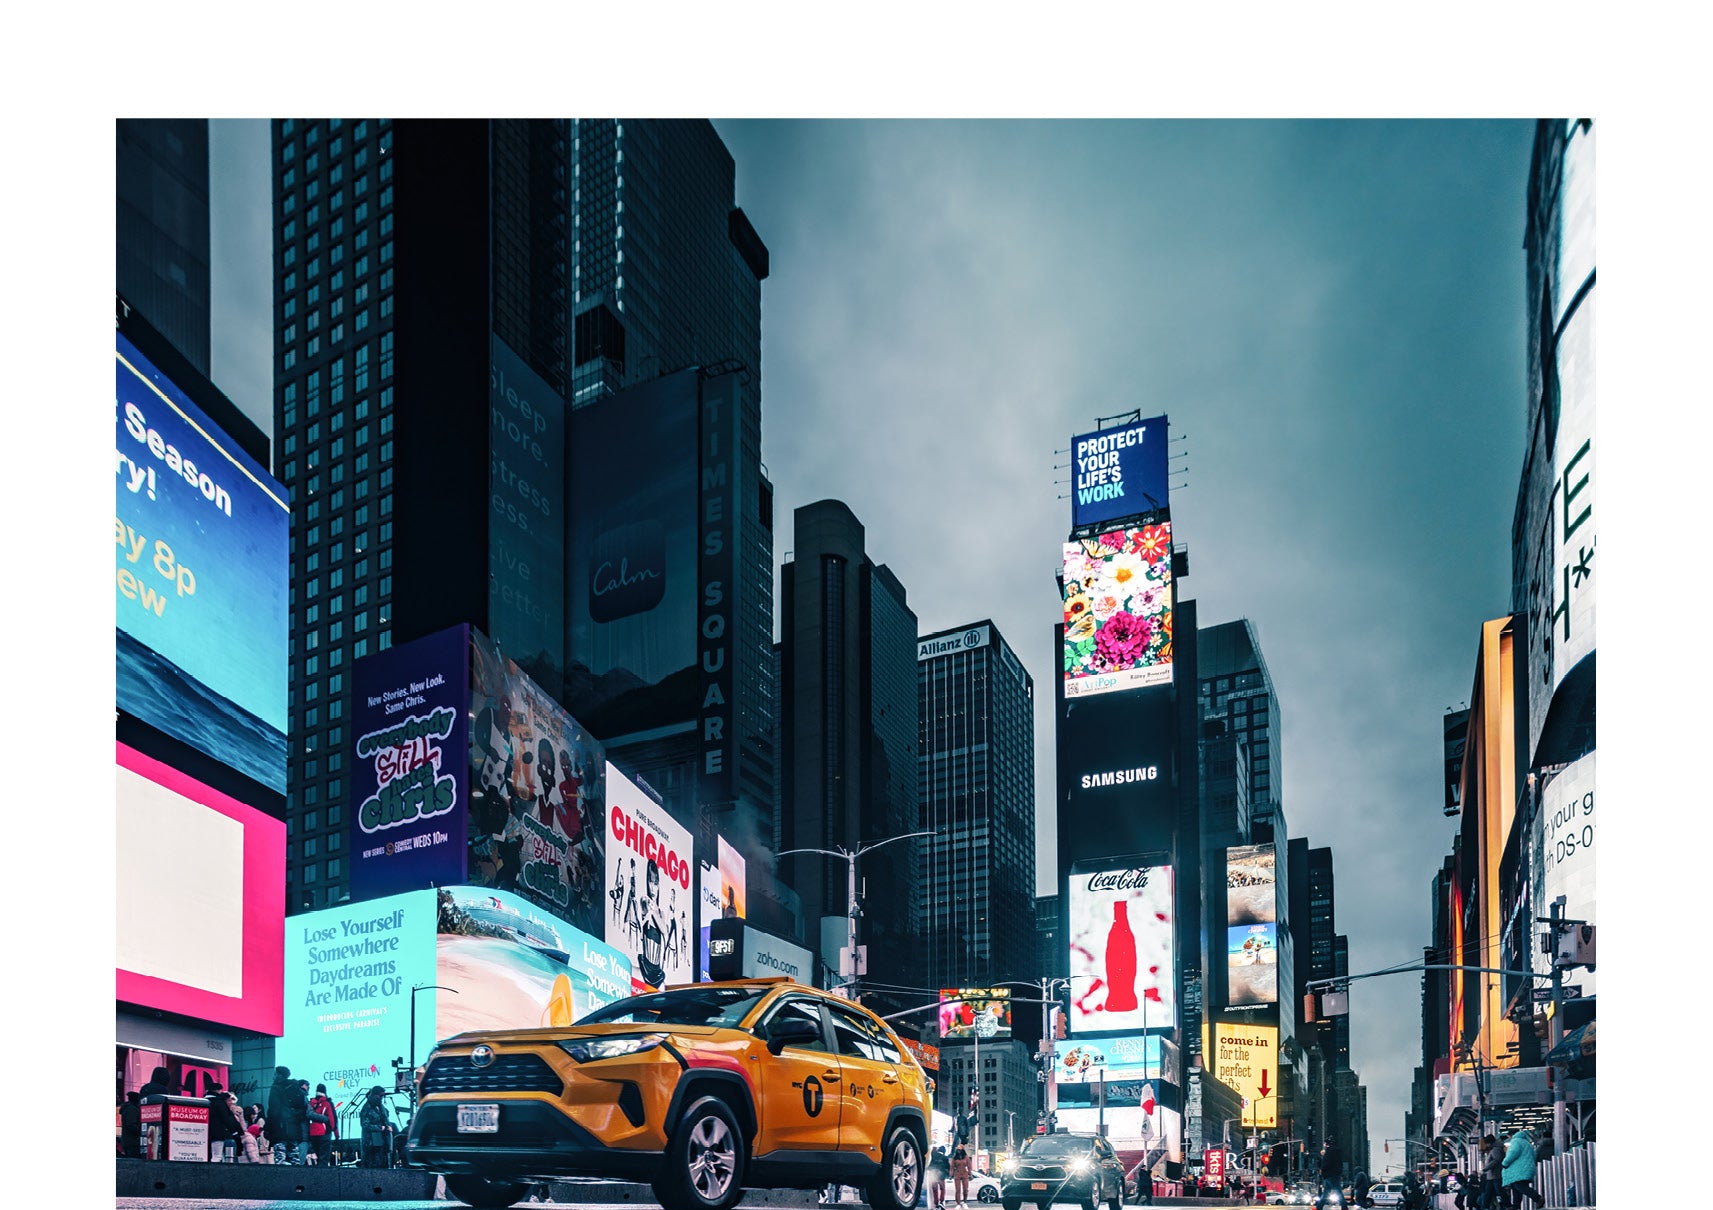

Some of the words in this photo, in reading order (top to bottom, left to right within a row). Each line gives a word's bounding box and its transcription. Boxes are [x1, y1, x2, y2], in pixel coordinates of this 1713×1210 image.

[1078, 427, 1146, 458] PROTECT
[124, 402, 231, 518] Season
[1077, 451, 1120, 474] YOUR
[702, 400, 726, 556] TIMES
[1078, 466, 1122, 489] LIFE'S
[1078, 482, 1125, 505] WORK
[154, 539, 197, 597] 8p
[592, 557, 661, 598] Calm
[919, 638, 962, 657] Allianz
[367, 696, 382, 708] New
[382, 687, 410, 703] Stories.
[410, 682, 426, 695] New
[425, 672, 446, 690] Look.
[702, 580, 725, 775] SQUARE
[384, 701, 405, 716] Same
[405, 694, 427, 709] Chris.
[358, 707, 456, 758] everybody
[1081, 766, 1158, 788] SAMSUNG
[358, 776, 456, 832] chris
[636, 808, 647, 824] PURE
[1550, 799, 1578, 840] your
[362, 849, 372, 859] NEW
[372, 846, 385, 857] SERIES
[413, 833, 432, 849] WEDS
[432, 831, 449, 845] 10PM
[611, 805, 690, 891] CHICAGO
[1088, 867, 1153, 892] Coca-Cola
[304, 927, 337, 945] Lose
[340, 908, 405, 937] Yourself
[308, 936, 400, 965] Somewhere
[583, 941, 608, 972] Lose
[309, 959, 397, 988] Daydreams
[756, 951, 799, 977] zoho.com
[304, 989, 332, 1008] Are
[334, 981, 378, 1003] Made
[381, 975, 403, 996] Of
[317, 1011, 354, 1023] INTRODUCING
[355, 1006, 388, 1017] CARNIVAL'S
[323, 1021, 351, 1033] EXCLUSIVE
[353, 1018, 381, 1029] PARADISE
[1220, 1036, 1254, 1046] come
[1255, 1035, 1269, 1047] in
[1220, 1045, 1234, 1060] for
[1234, 1046, 1250, 1061] the
[323, 1066, 381, 1082] CELEBRATION
[343, 1078, 361, 1090] KEY
[1220, 1063, 1252, 1080] perfect
[170, 1106, 198, 1114] MUSEUM
[170, 1112, 208, 1120] BROADWAY
[1209, 1151, 1222, 1174] tkts
